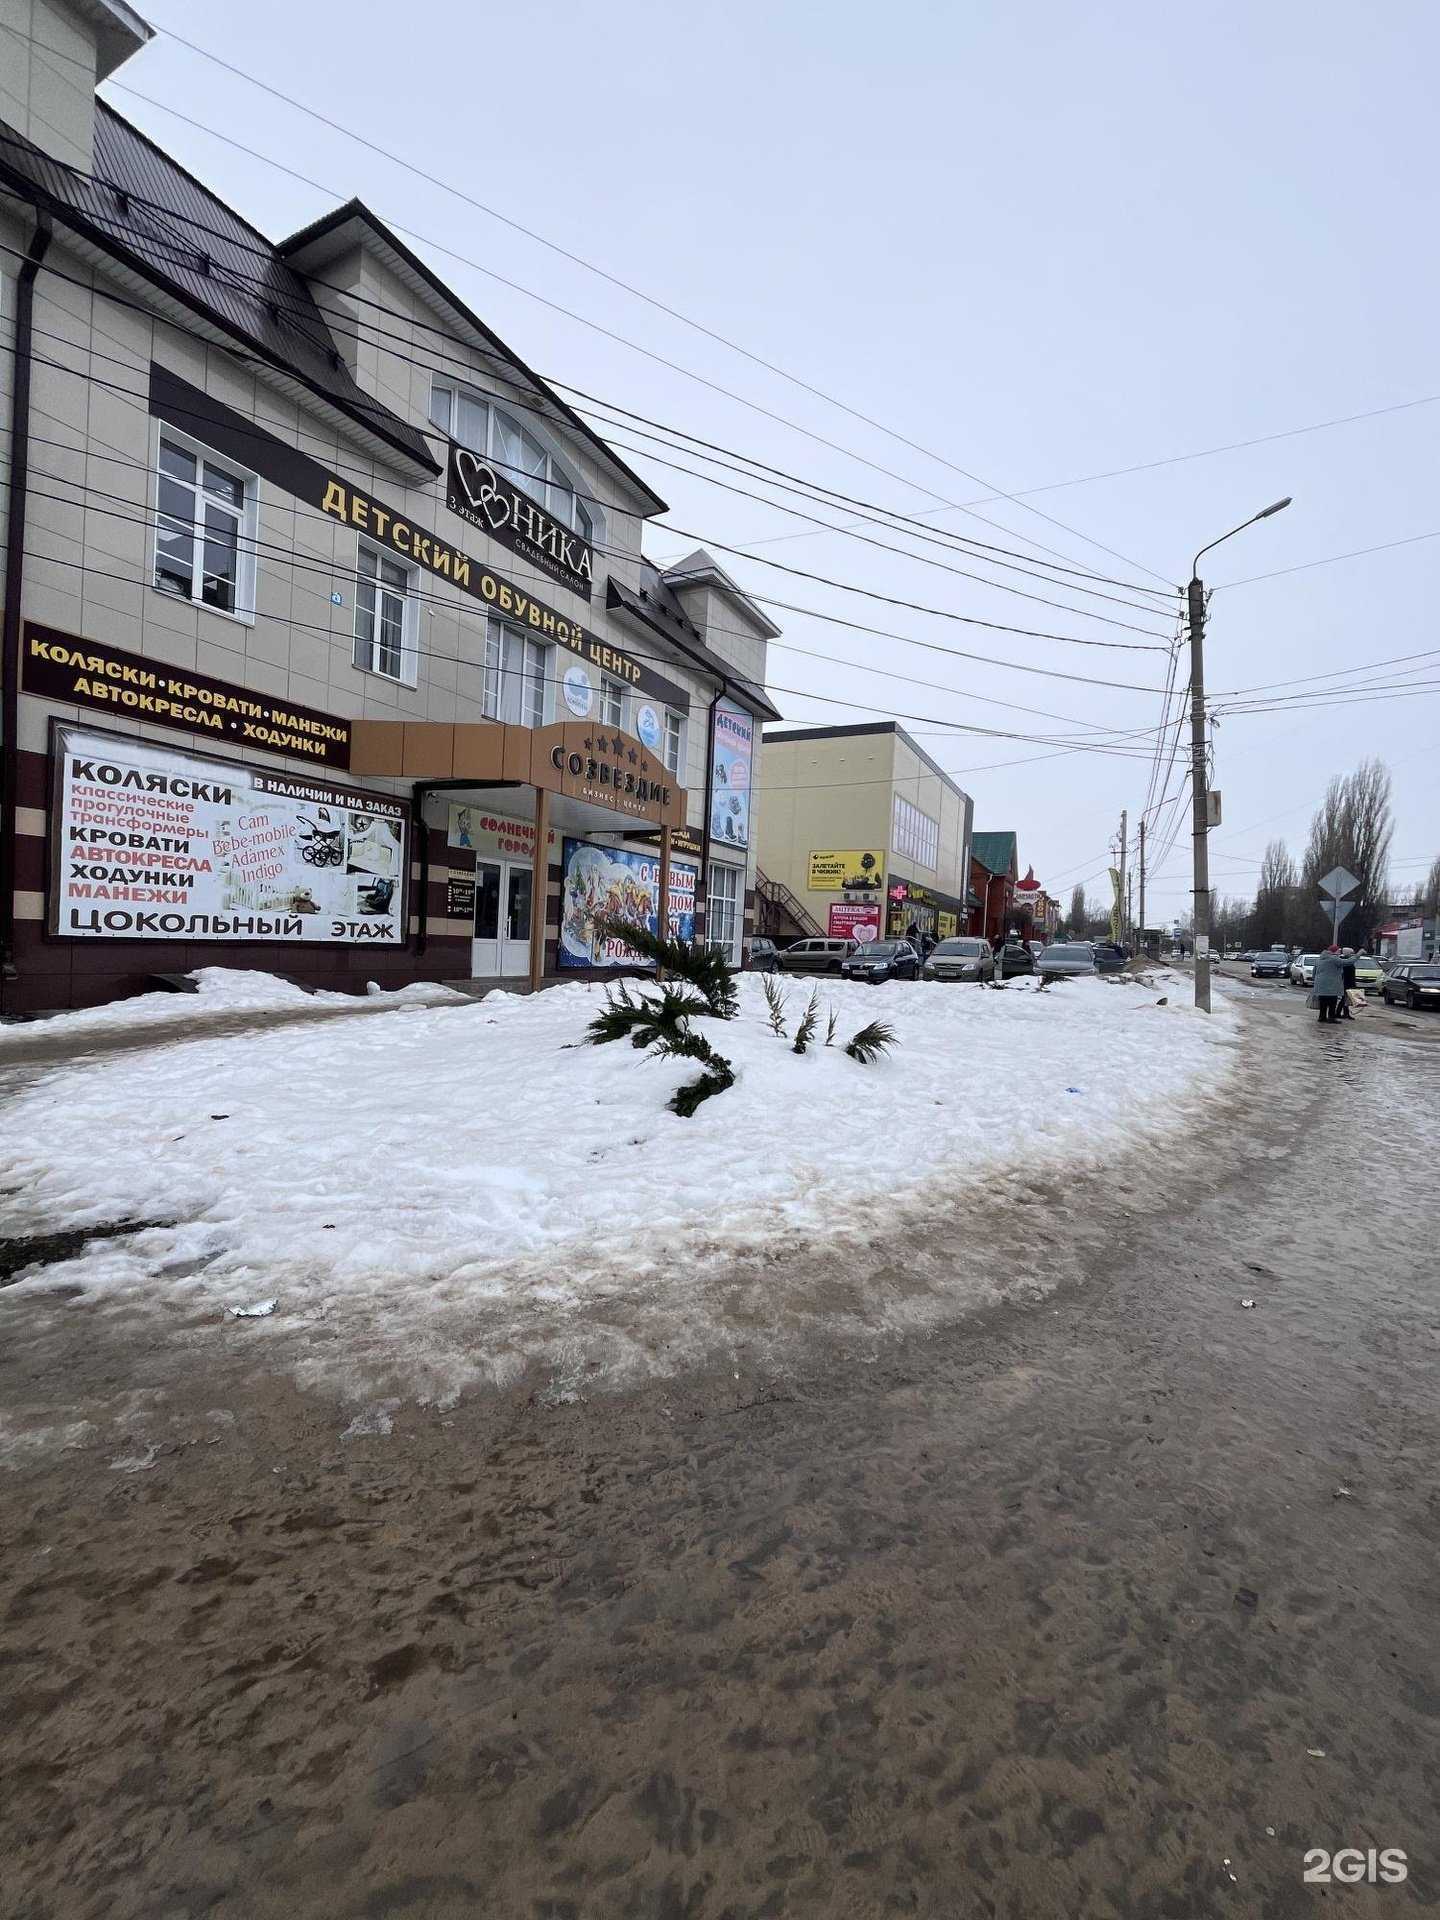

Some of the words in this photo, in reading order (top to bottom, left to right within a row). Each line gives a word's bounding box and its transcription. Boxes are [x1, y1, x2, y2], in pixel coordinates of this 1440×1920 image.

[450, 496, 456, 509] 3
[459, 505, 484, 528] этаж
[511, 493, 592, 582] НИКА
[322, 480, 470, 587] ДЕТСКИЙ
[481, 575, 582, 650] ОБУВНОЙ
[590, 643, 641, 681] ЦЕНТР
[31, 640, 156, 688] КОЛЯСКИ
[168, 680, 262, 718] КРОВАТИ
[272, 710, 347, 742] МАНЕЖИ
[73, 678, 223, 729] АВТОКРЕСЛА
[243, 722, 326, 756] ХОДУНКИ
[72, 759, 232, 805] КОЛЯСКИ
[551, 746, 670, 805] СОЗВЕЗДИЕ
[72, 784, 194, 812] классические
[254, 778, 263, 788] В
[268, 780, 332, 802] НАЛИЧИИ
[335, 794, 344, 804] И
[348, 797, 363, 809] НА
[366, 802, 401, 815] ЗАКАЗ
[71, 811, 209, 839] трансформеры
[72, 798, 190, 824] прогулочные
[239, 814, 269, 830] Cam
[70, 827, 190, 854] КРОВАТИ
[213, 824, 296, 855] Bebe-mobile
[480, 817, 554, 844] СОЛНЕЧНЙ
[70, 845, 212, 872] АВТОКРЕСЛА
[231, 847, 285, 868] Adamex
[70, 864, 194, 887] ХОДУНКИ
[242, 863, 283, 883] Indigo
[654, 867, 694, 889] НВЫМ
[68, 883, 187, 904] МАНЕЖИ
[71, 908, 302, 935] ЦОКОЛЬНЫЙ
[331, 921, 393, 938] ЭТАЖ
